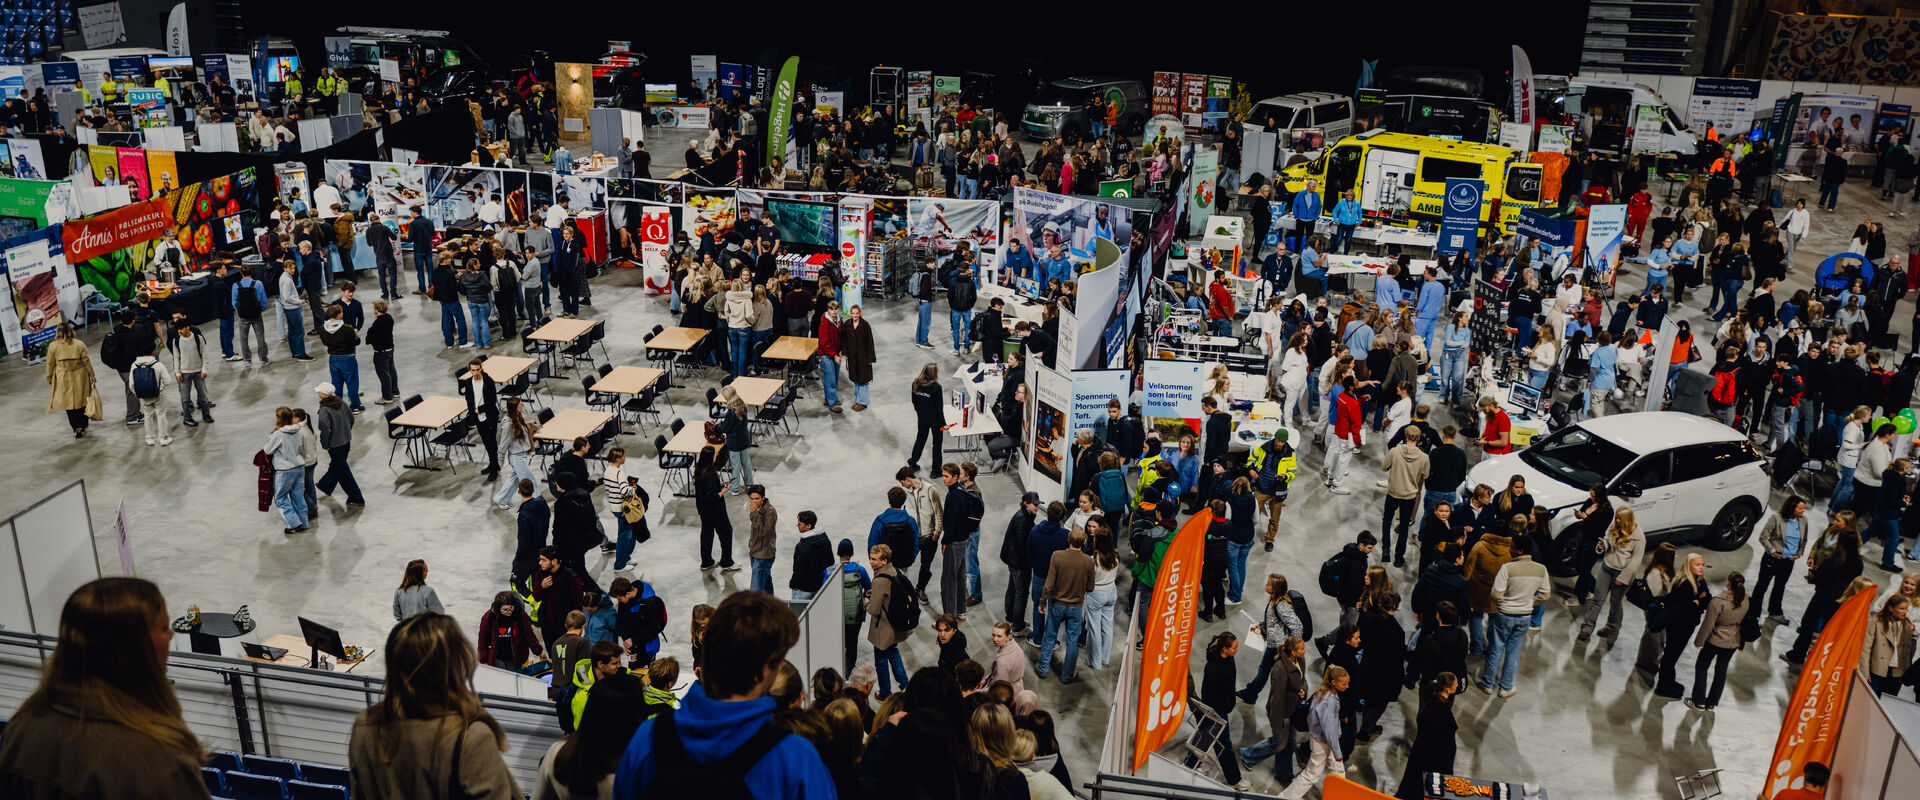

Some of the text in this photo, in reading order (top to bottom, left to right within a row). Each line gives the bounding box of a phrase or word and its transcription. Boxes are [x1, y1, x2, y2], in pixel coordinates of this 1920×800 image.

[771, 102, 786, 156] Hagelan
[71, 225, 113, 254] Annis
[119, 231, 129, 240] OG
[646, 224, 666, 240] Q
[1517, 221, 1562, 241] gdomsarbeiderfaget
[1148, 382, 1193, 391] Velkommen
[1165, 391, 1193, 401] lærling
[1158, 560, 1181, 665] Fagskolen
[1175, 581, 1194, 658] Innlandet
